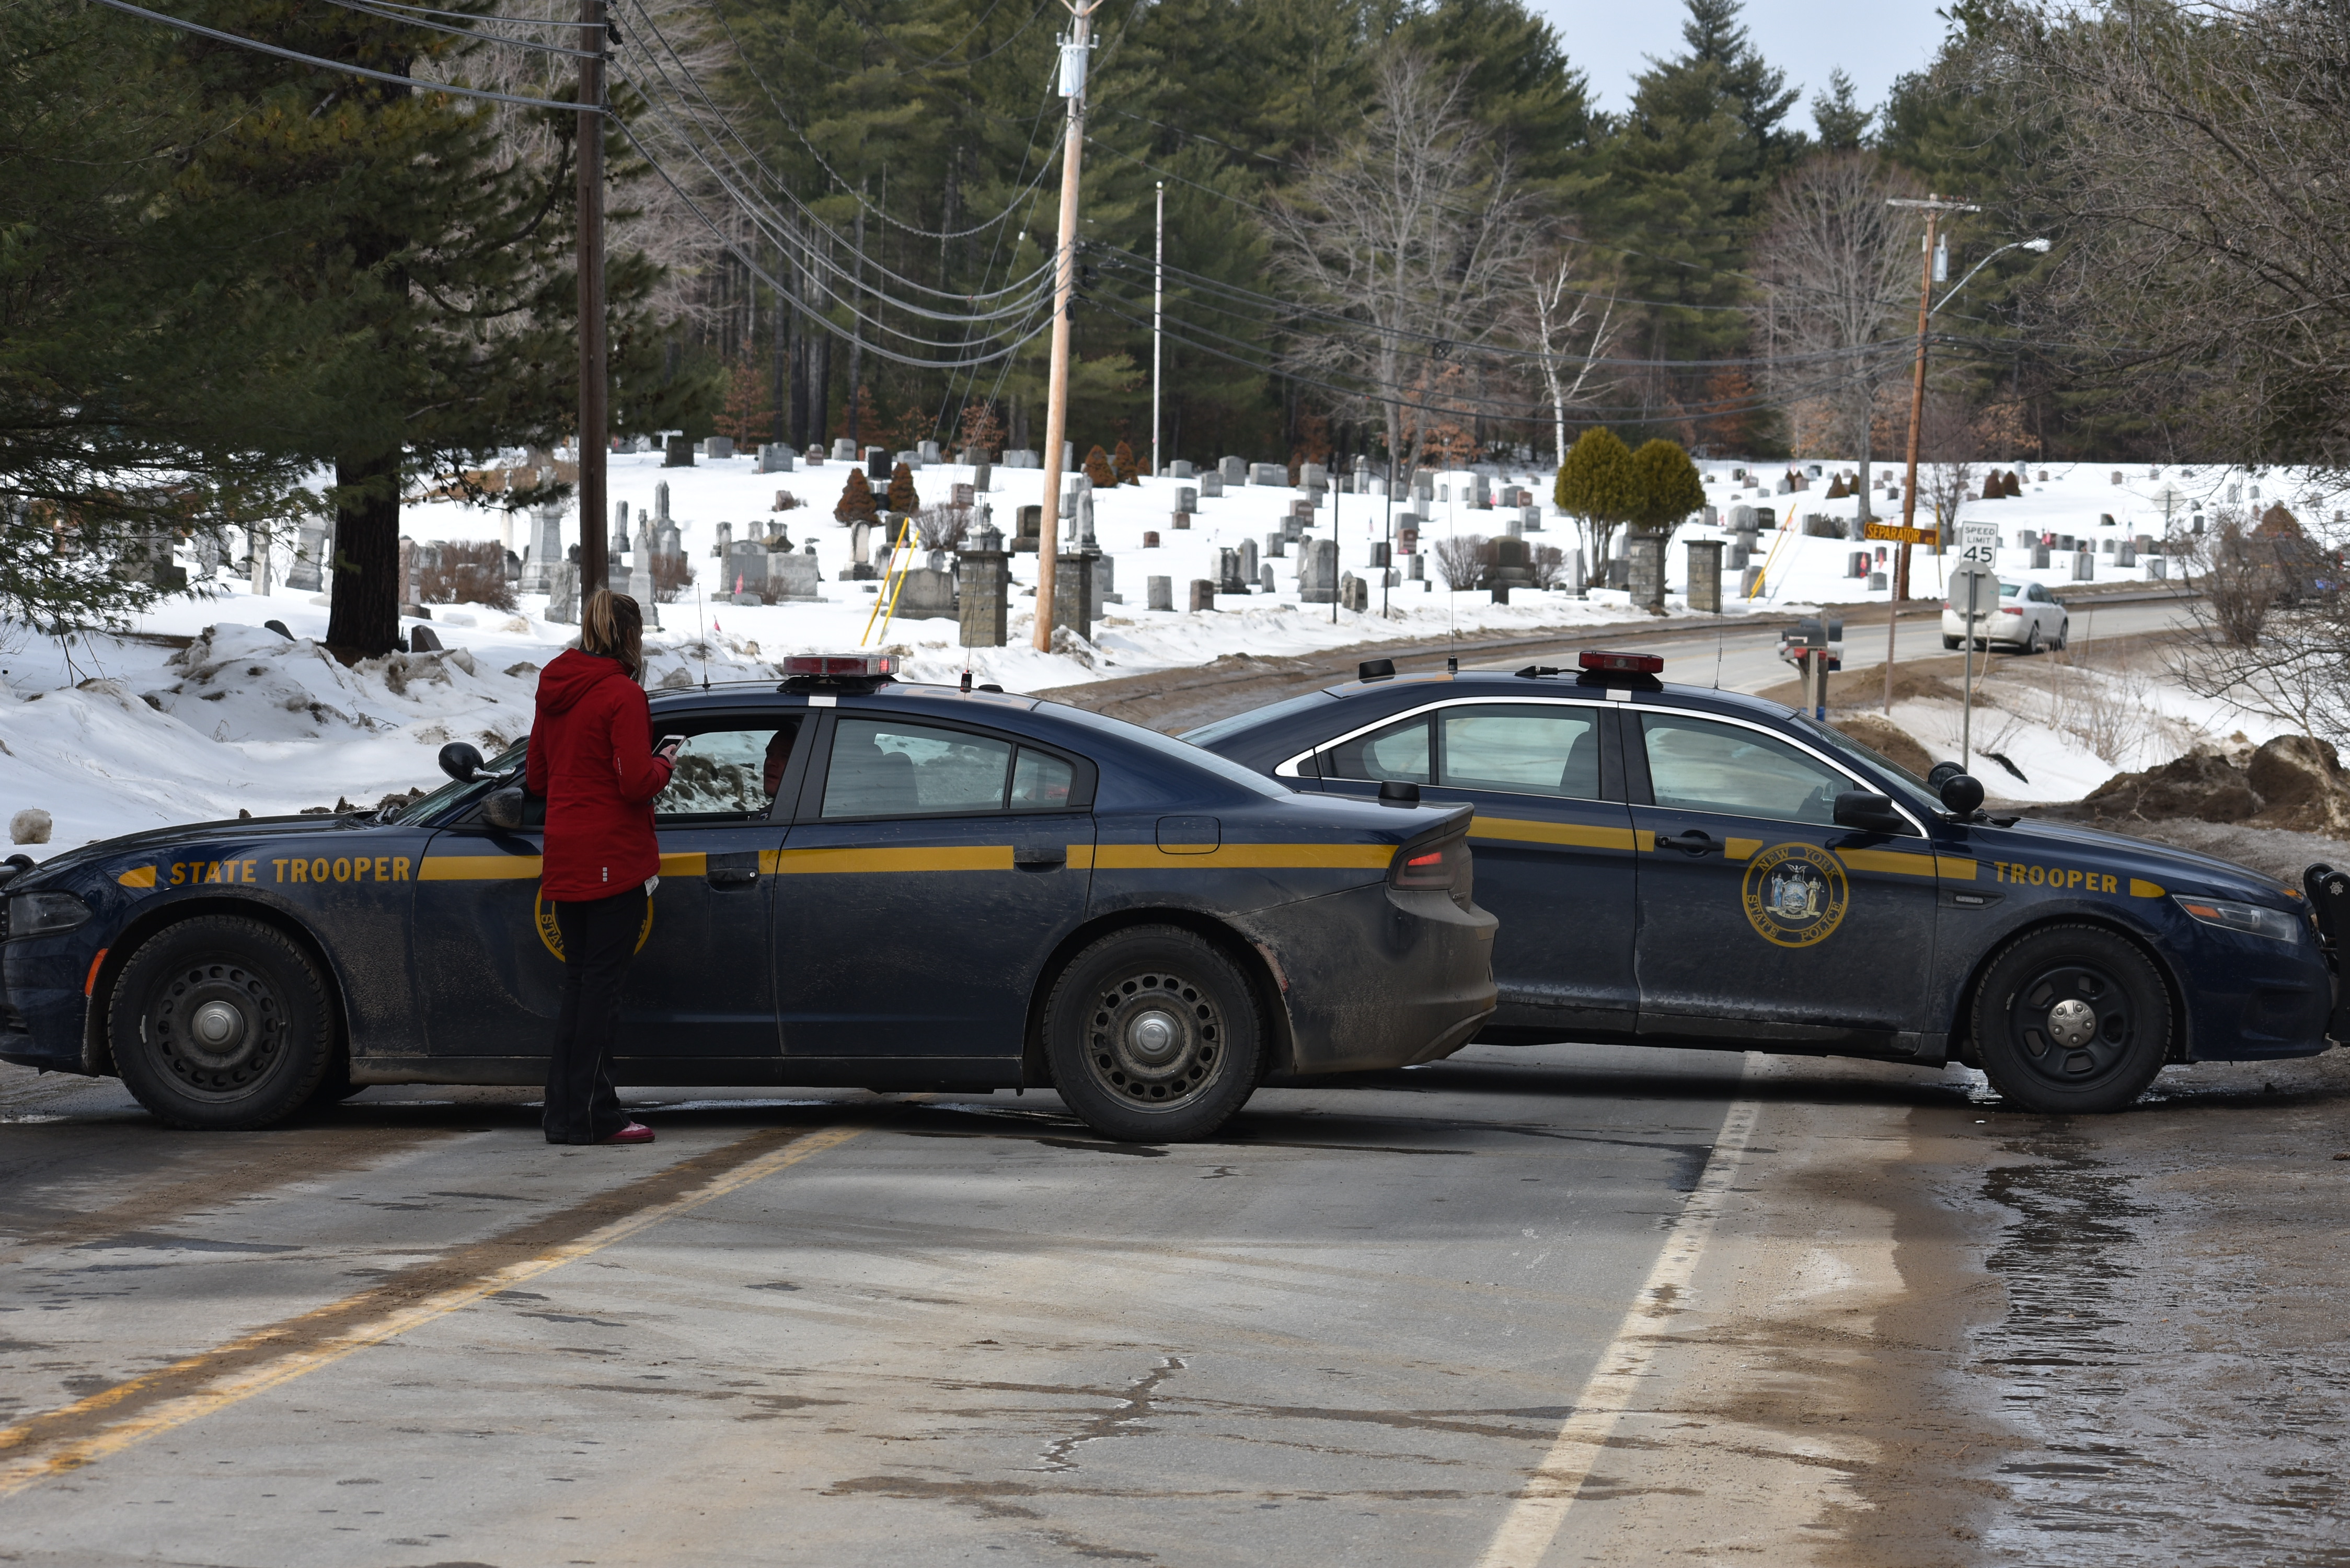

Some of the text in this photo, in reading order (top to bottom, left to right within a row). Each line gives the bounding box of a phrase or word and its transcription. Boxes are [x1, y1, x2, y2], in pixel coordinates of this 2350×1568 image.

[1867, 524, 1920, 543] SEPARATOR
[1965, 526, 1995, 536] SPEED
[1963, 546, 1992, 562] 45
[169, 856, 410, 885] STATE TROOPER
[1757, 847, 1839, 880] NEW YORK
[1994, 861, 2117, 894] TROOPER
[1746, 894, 1842, 942] STATE POLICE
